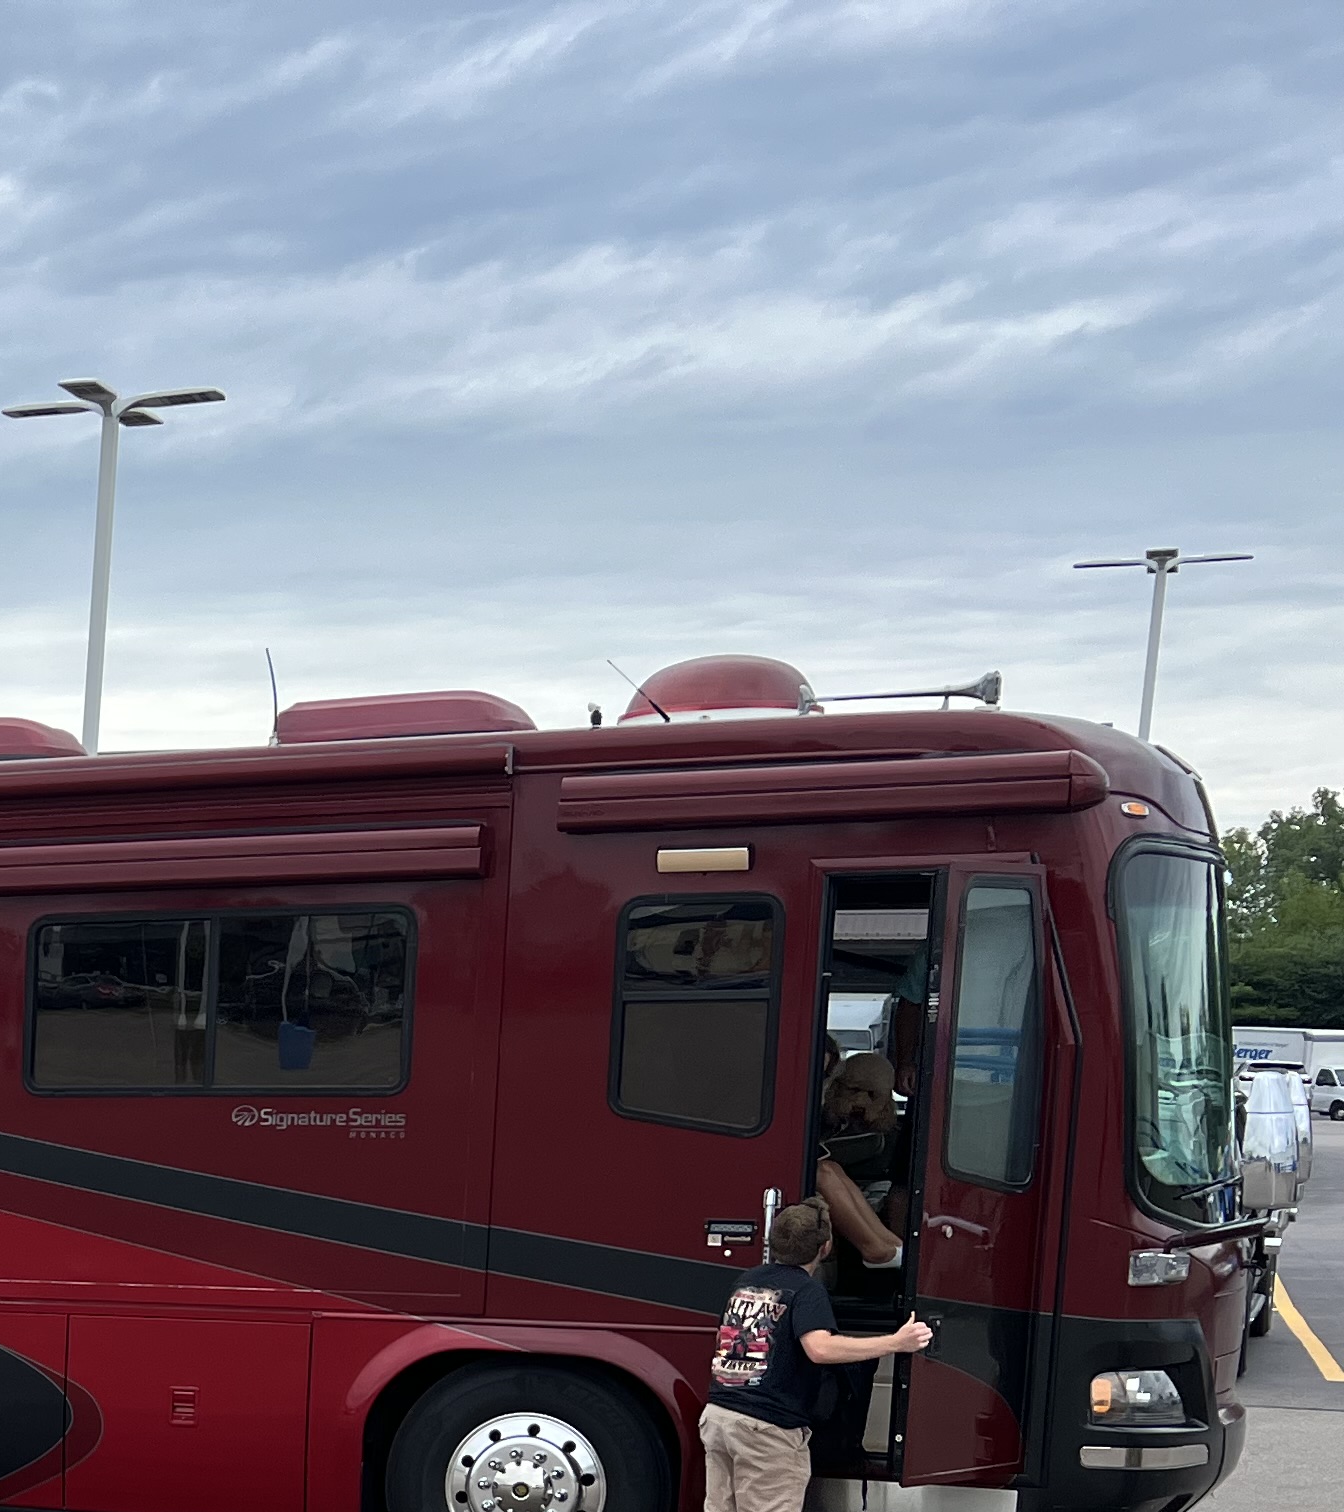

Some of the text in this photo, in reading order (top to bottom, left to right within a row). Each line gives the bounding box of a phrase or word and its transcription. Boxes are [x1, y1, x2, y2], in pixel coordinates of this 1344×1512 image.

[260, 1107, 406, 1129] Signature Series
[349, 1131, 406, 1139] MONACO
